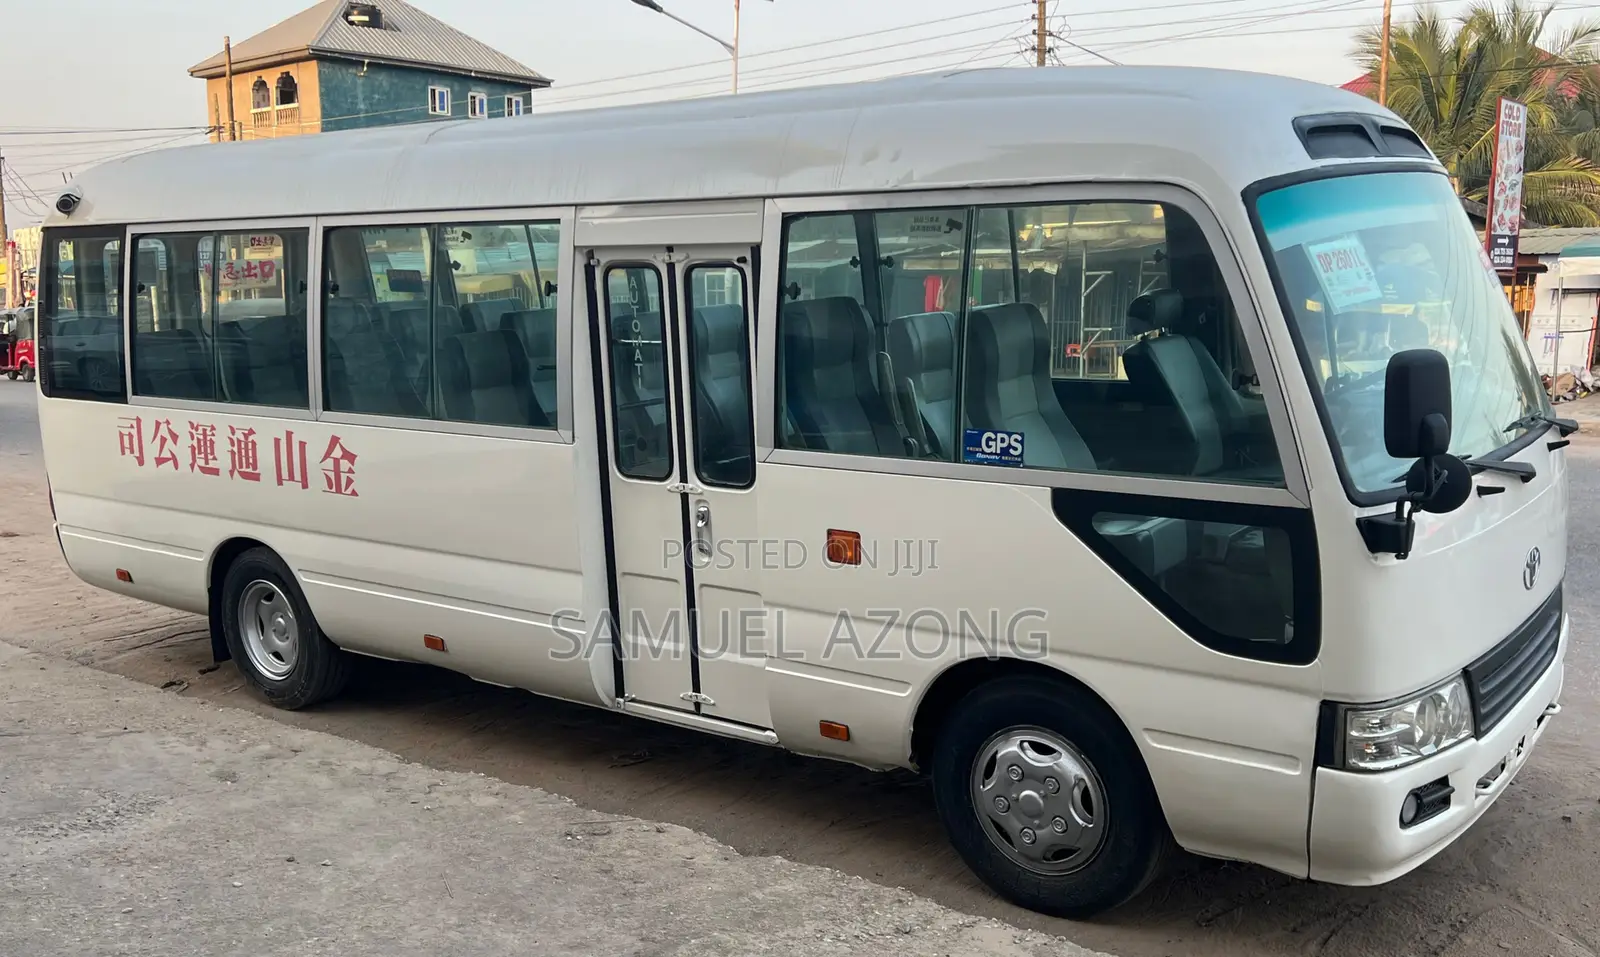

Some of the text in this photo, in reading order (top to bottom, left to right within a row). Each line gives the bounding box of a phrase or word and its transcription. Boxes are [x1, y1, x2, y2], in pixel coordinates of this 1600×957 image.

[1504, 104, 1521, 122] COLD
[1501, 119, 1522, 138] STORE
[981, 431, 1023, 456] GPS
